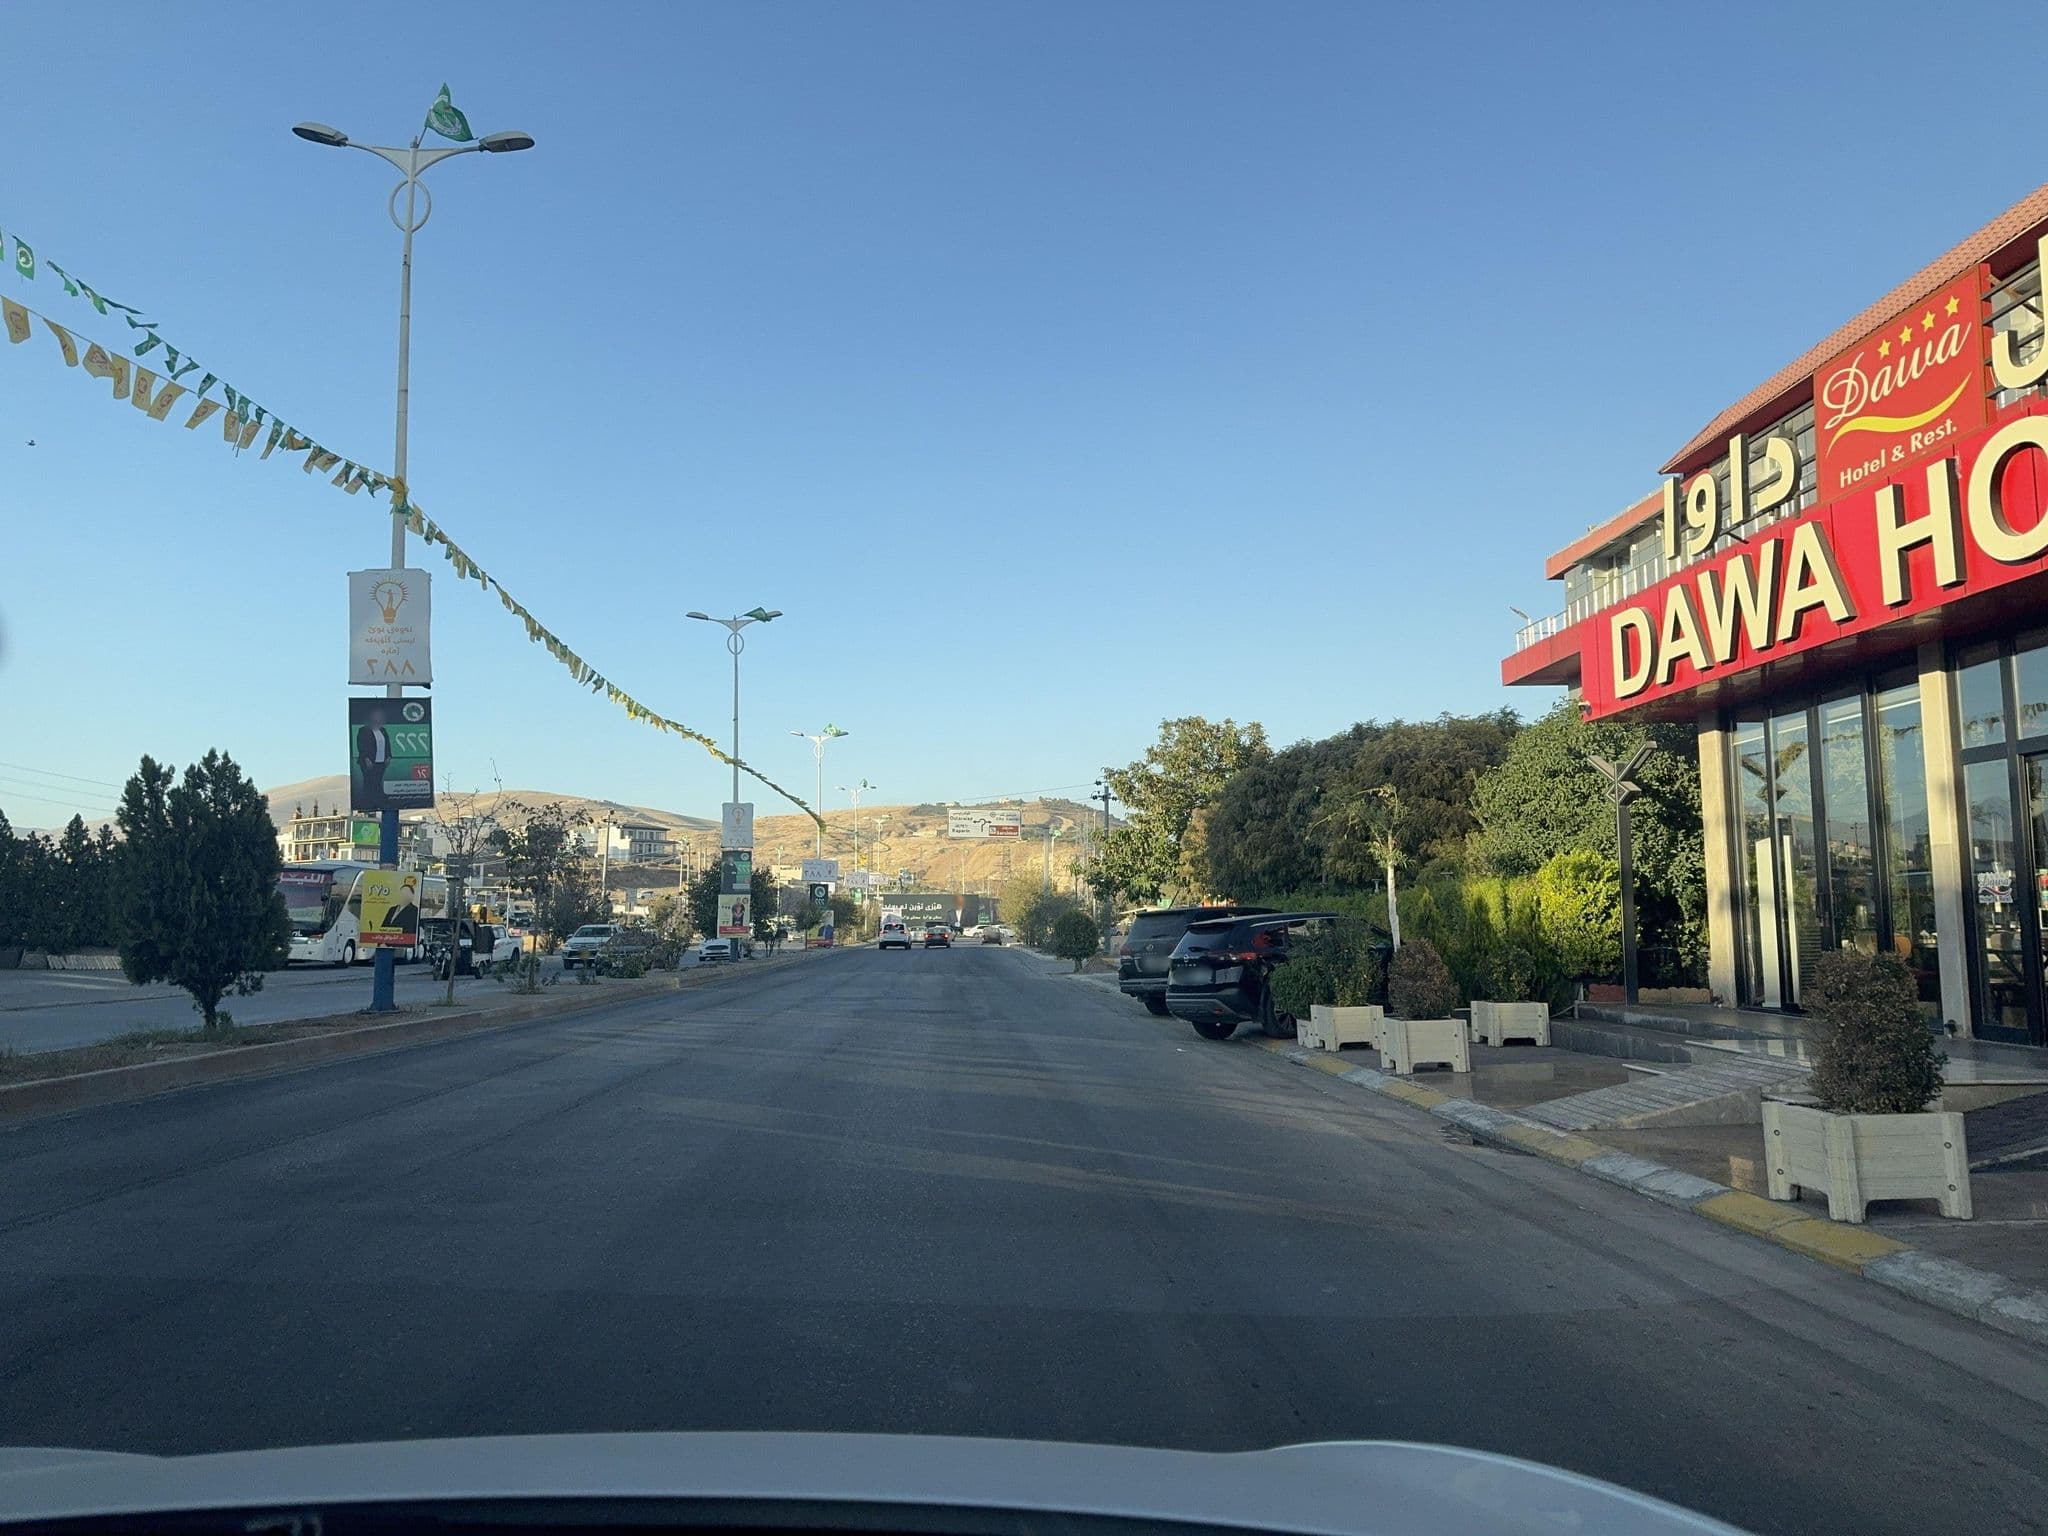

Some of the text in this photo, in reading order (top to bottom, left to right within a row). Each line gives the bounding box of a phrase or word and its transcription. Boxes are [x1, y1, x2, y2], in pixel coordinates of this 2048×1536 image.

[1822, 321, 1973, 430] Dawa
[1839, 417, 1957, 489] Hotel & Rest.
[1611, 520, 1857, 699] DAWA
[395, 732, 428, 753] ٢٢٢
